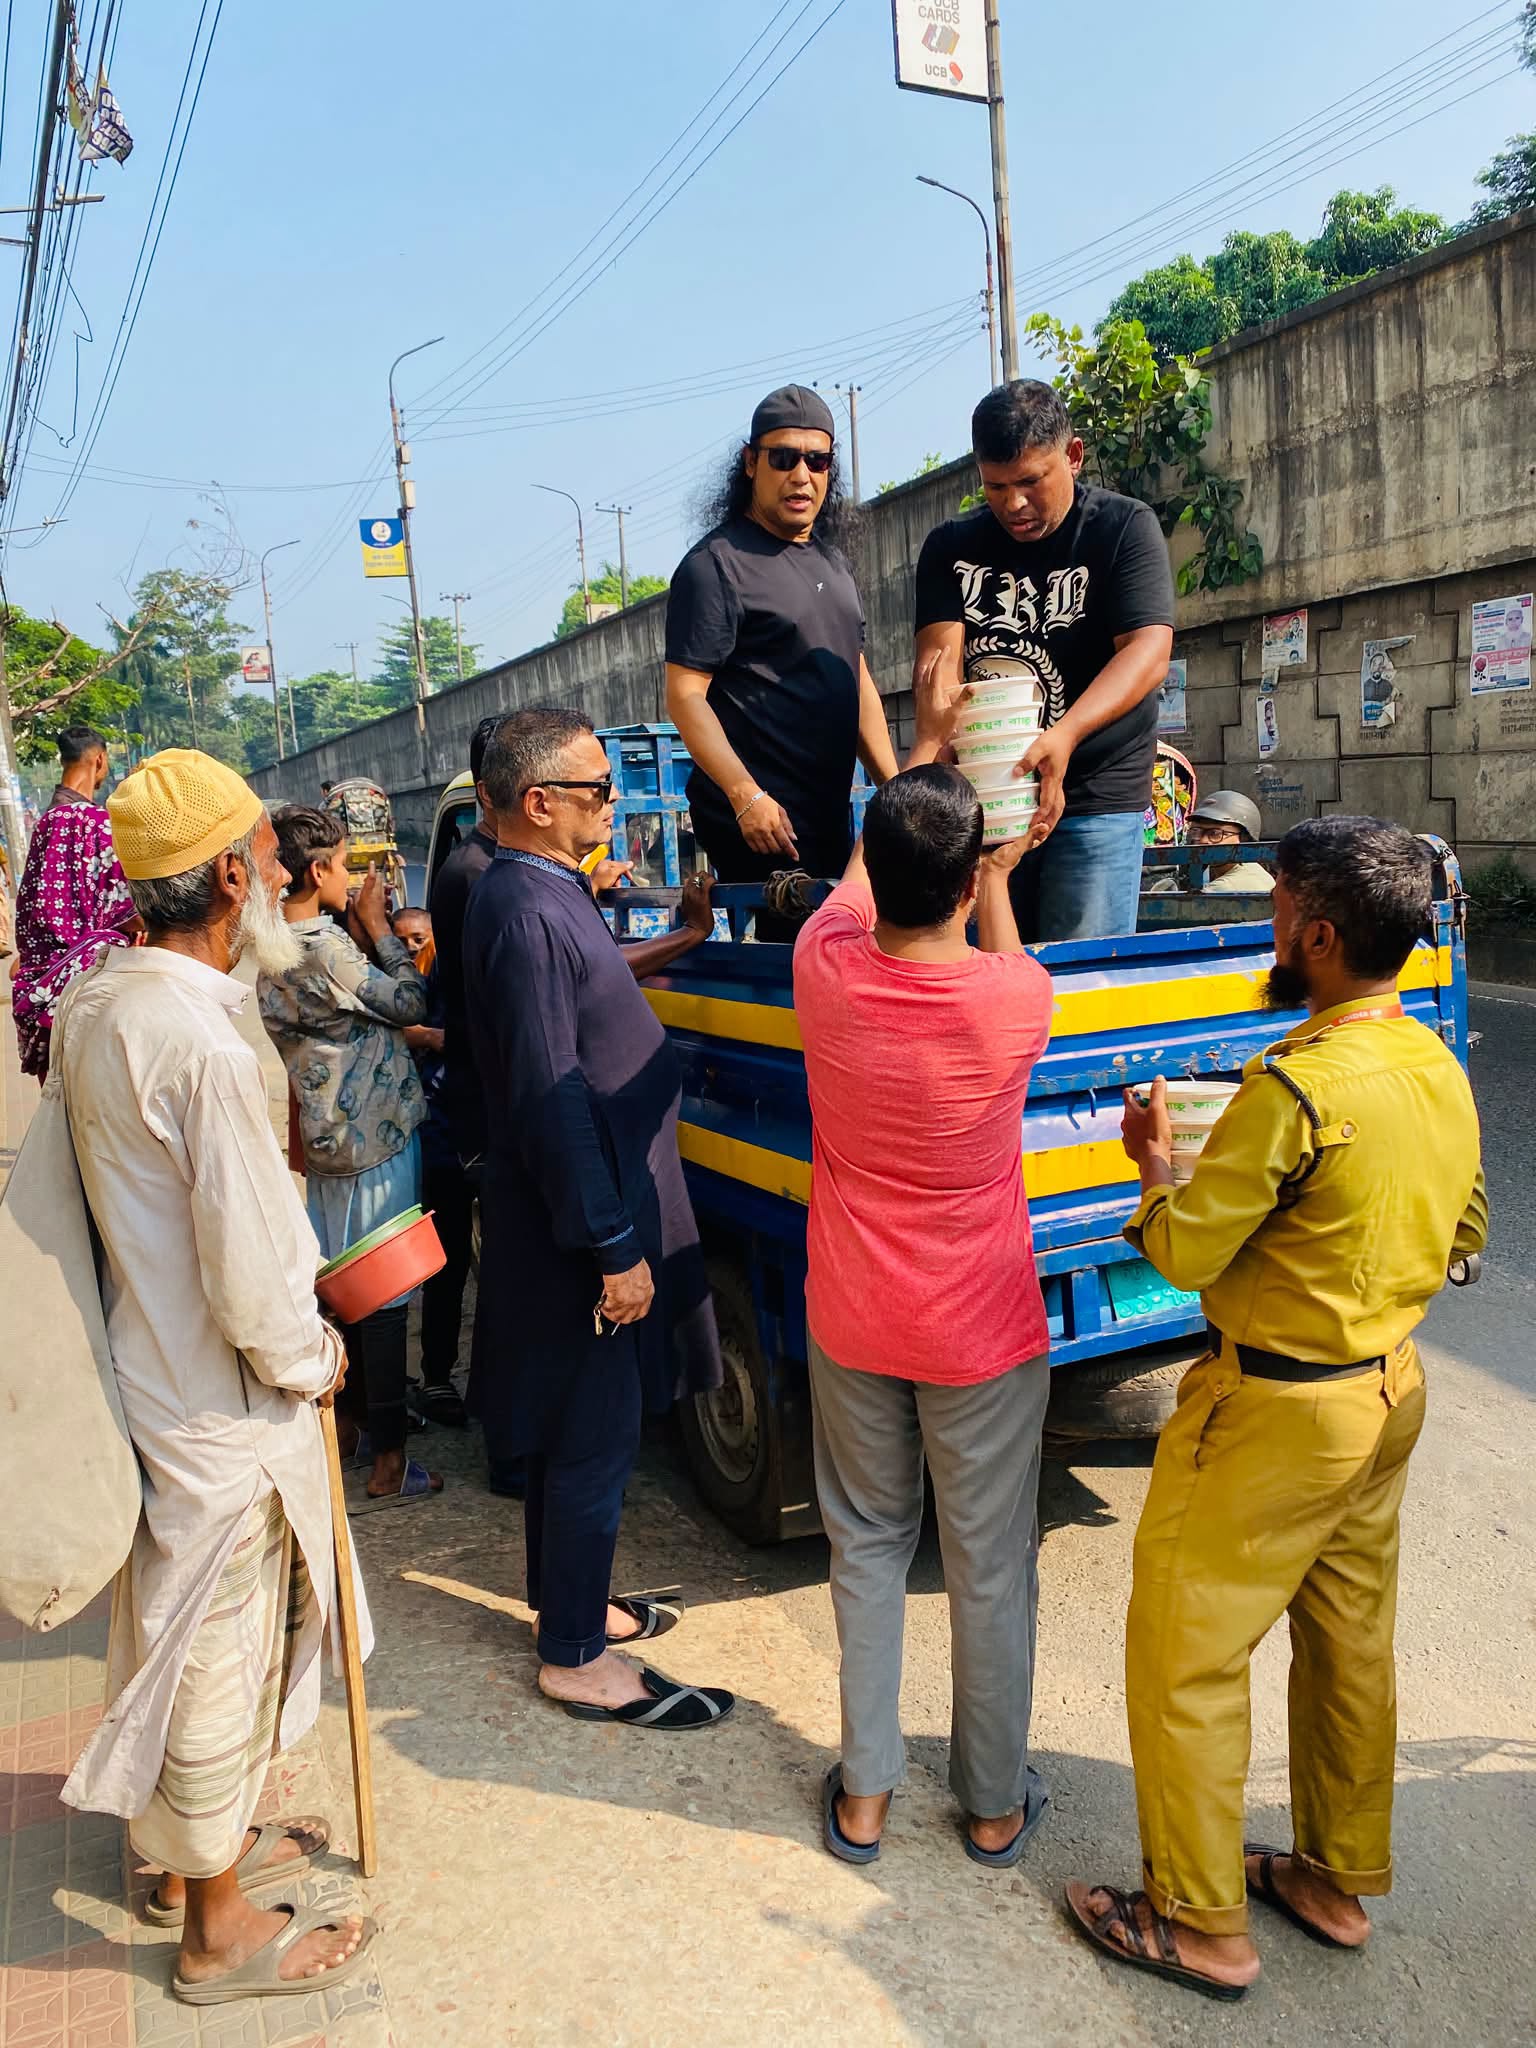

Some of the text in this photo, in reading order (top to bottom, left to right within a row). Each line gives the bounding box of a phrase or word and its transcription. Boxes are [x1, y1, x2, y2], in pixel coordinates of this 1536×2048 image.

[918, 5, 960, 25] CARDS
[924, 63, 948, 78] UCB
[953, 560, 1090, 639] LRB
